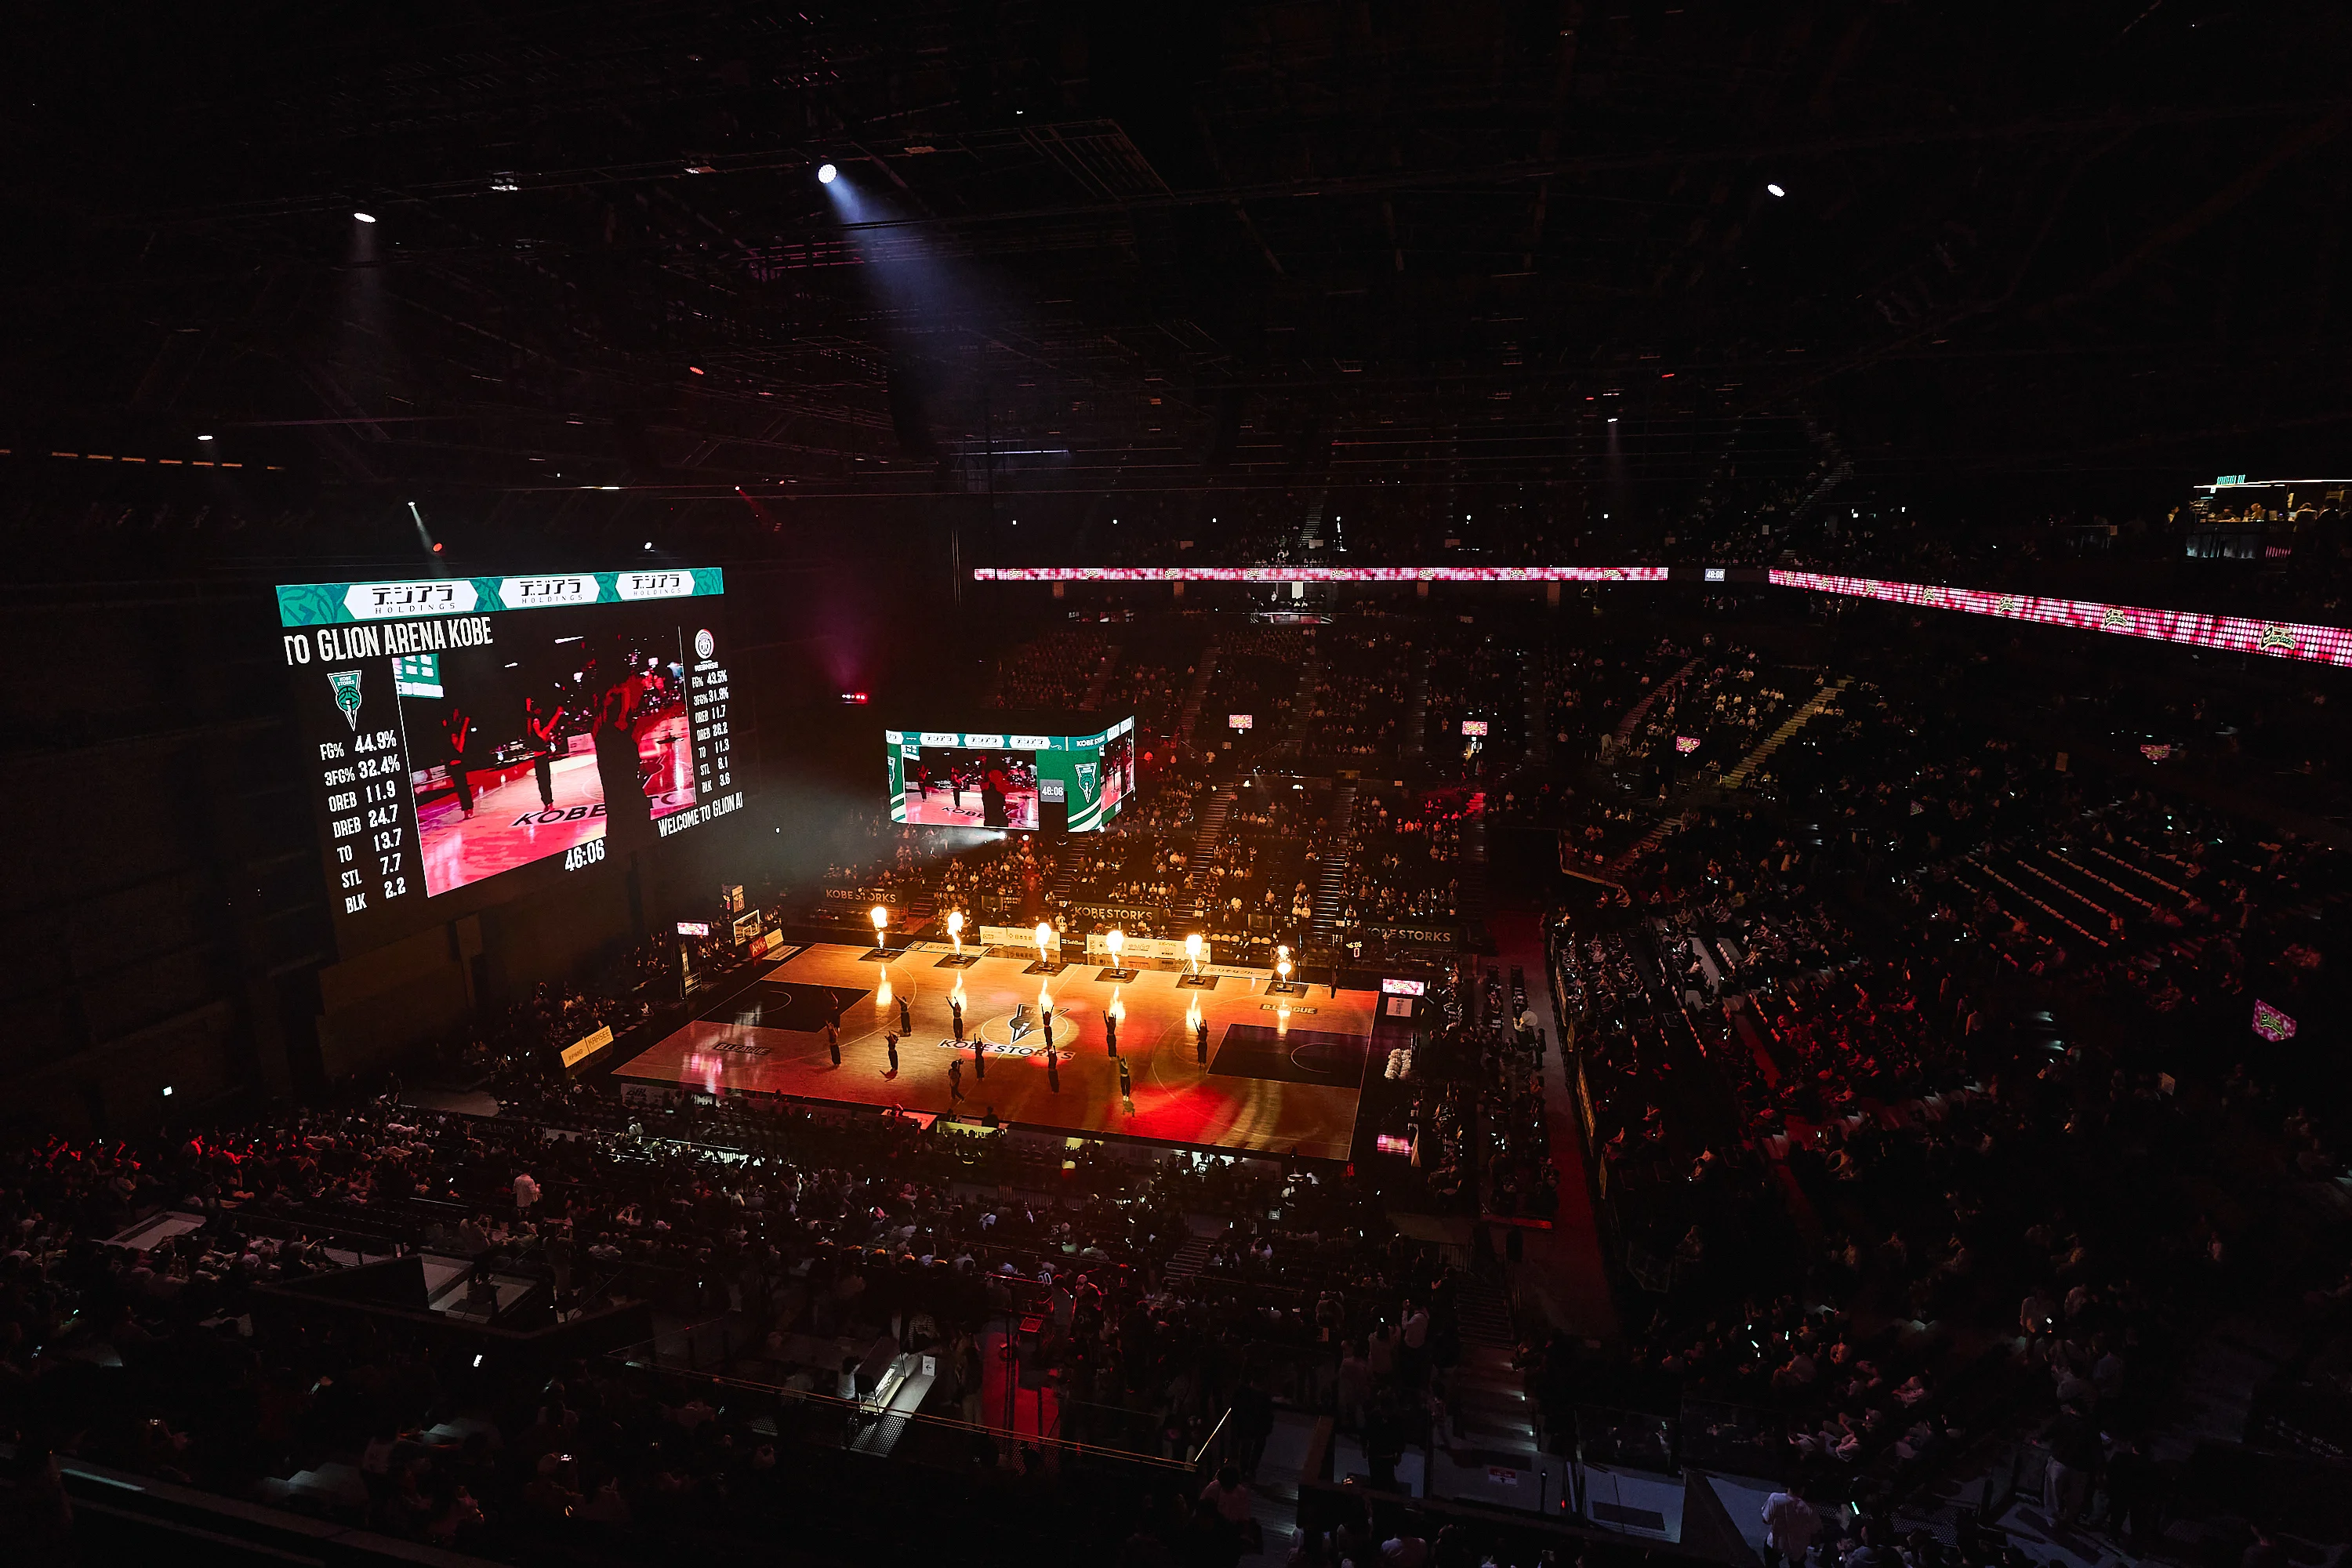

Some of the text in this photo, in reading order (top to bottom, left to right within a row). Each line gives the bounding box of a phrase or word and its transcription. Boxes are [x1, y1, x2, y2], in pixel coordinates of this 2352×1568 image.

[520, 579, 581, 596] デジアラ
[633, 574, 680, 590] デジアラ
[372, 584, 452, 605] デジアラ
[522, 594, 583, 604] HOLDINGS
[633, 588, 681, 597] HOLDINGS
[376, 603, 455, 614] HOLDINGS
[317, 625, 381, 662] GLION
[383, 619, 448, 655] ARENA
[447, 616, 493, 649] KOBE
[691, 669, 728, 688] FG% 43.5%
[693, 686, 729, 706] 3FG% 31.9%
[695, 704, 726, 724] OREB 11.7
[696, 721, 728, 742] DREB 26.2
[319, 729, 397, 760] FG% 44.9%
[698, 739, 730, 758] TO 11.3
[324, 753, 401, 786] 3FG% 32.4%
[700, 756, 728, 776] STL 8.1
[702, 771, 731, 793] BLK 3.6
[1041, 786, 1064, 797] 46:06
[328, 780, 396, 812] OREB 11.9
[332, 804, 398, 838] DREB 24.7
[658, 808, 700, 837] WELCOME
[699, 804, 711, 822] TO
[712, 793, 735, 818] GLION
[336, 827, 402, 863] TO 13.7
[564, 838, 605, 871] 46:06
[341, 852, 401, 888] STL 7.7
[345, 877, 406, 914] BLK 2.2
[826, 889, 853, 900] KOBE
[1107, 908, 1152, 921] STORKS
[1399, 929, 1451, 942] STORKS
[1353, 947, 1360, 958] 0
